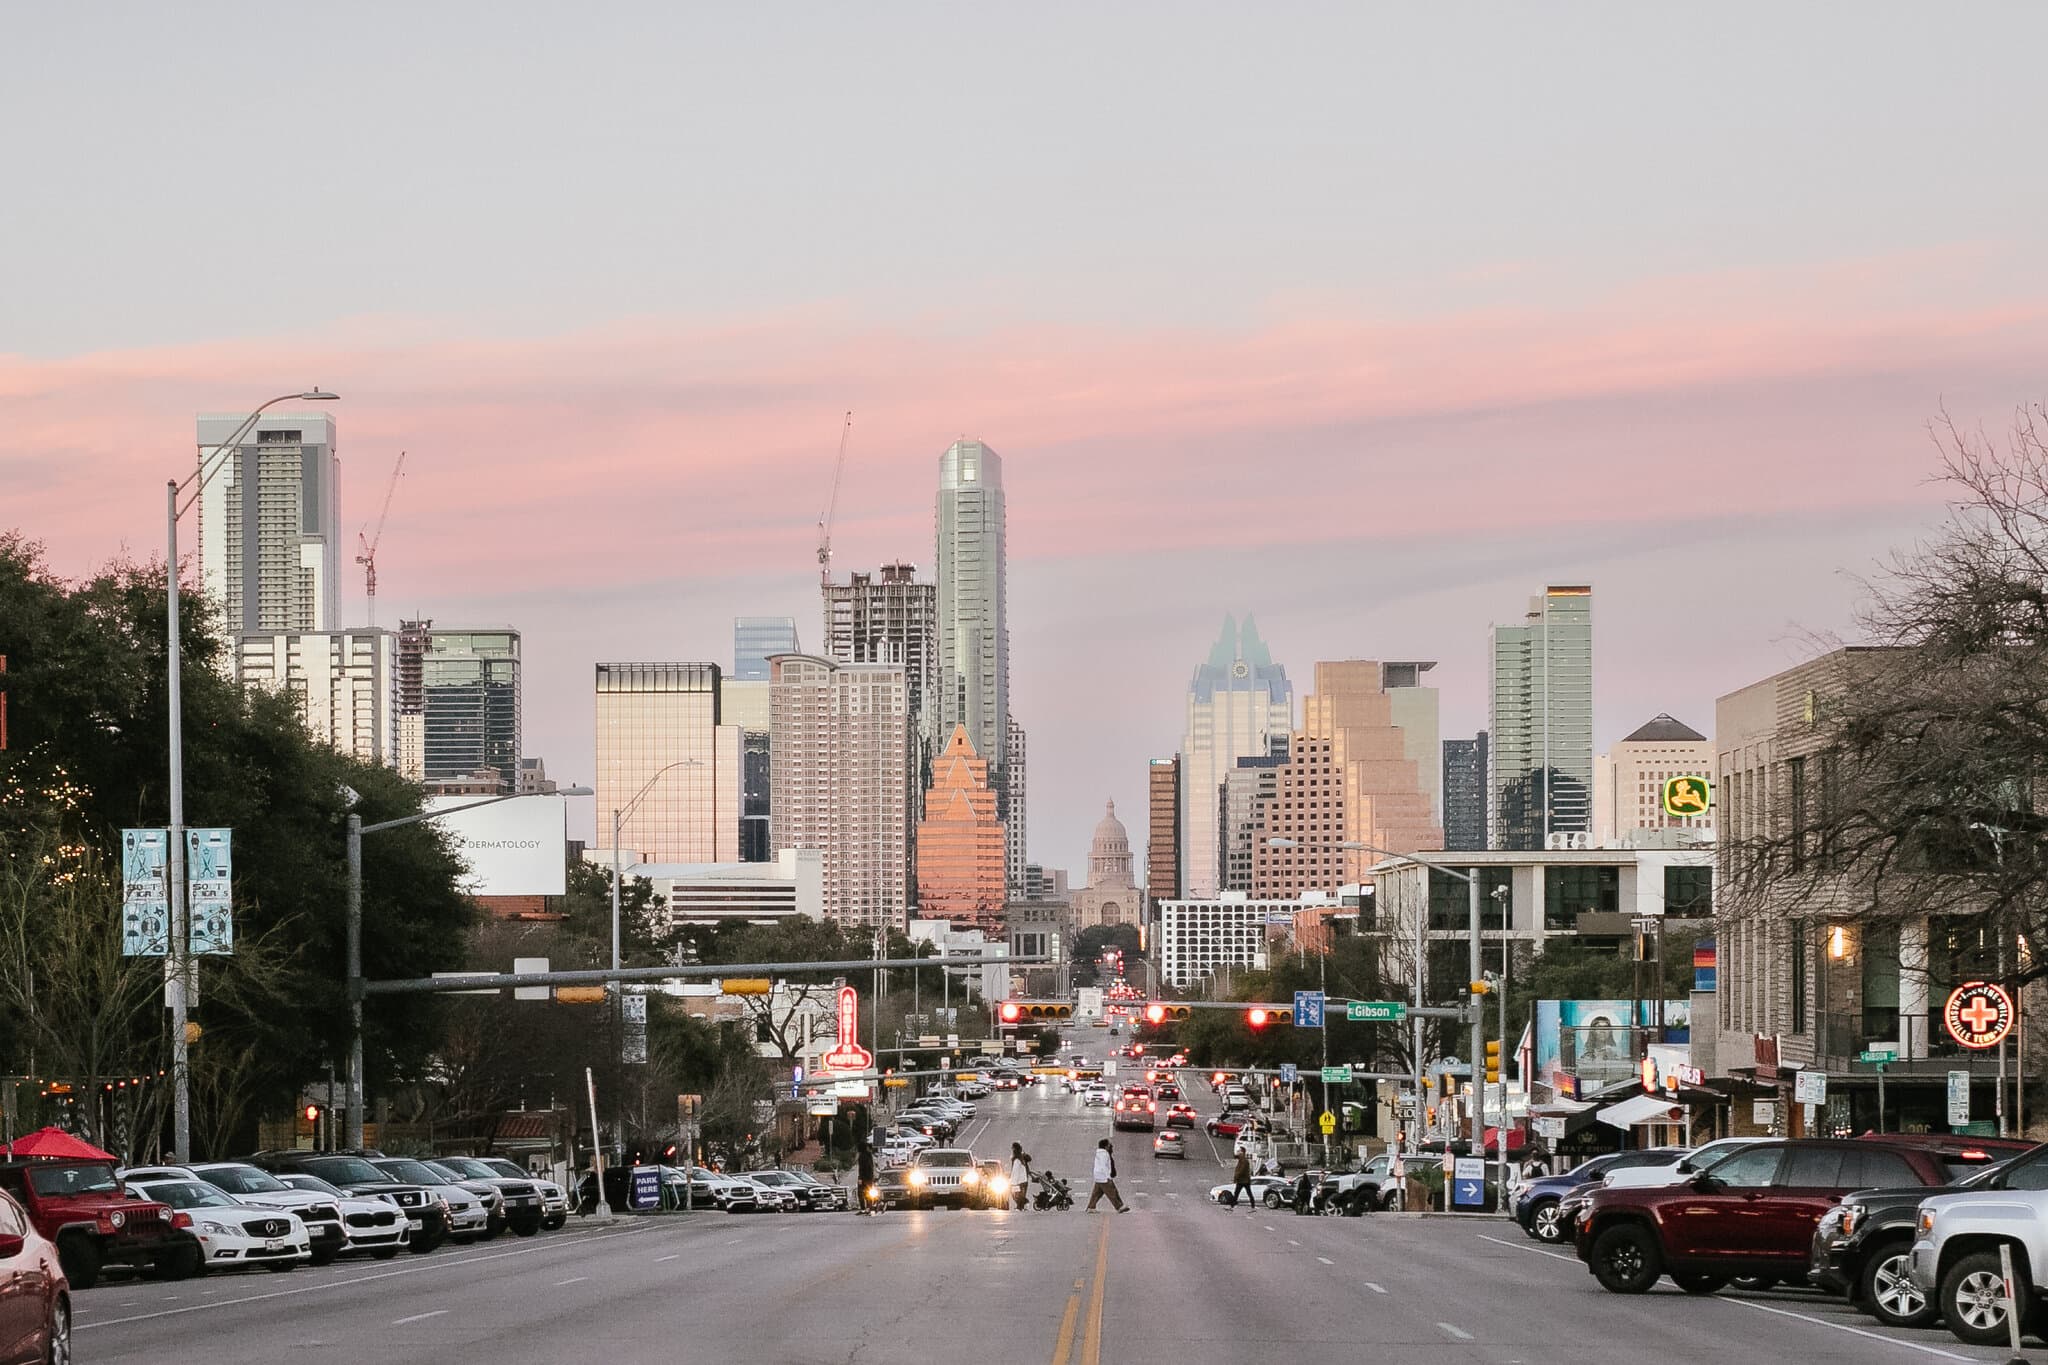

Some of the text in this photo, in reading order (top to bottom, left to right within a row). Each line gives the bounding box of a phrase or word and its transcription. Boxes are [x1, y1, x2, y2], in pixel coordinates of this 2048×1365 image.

[468, 840, 541, 849] DERMATOLOGY
[1355, 1005, 1390, 1017] Gibson
[842, 993, 853, 1053] AUSTIN
[828, 1053, 865, 1065] MOTEL
[636, 1176, 658, 1184] PARK
[637, 1185, 659, 1194] HERE
